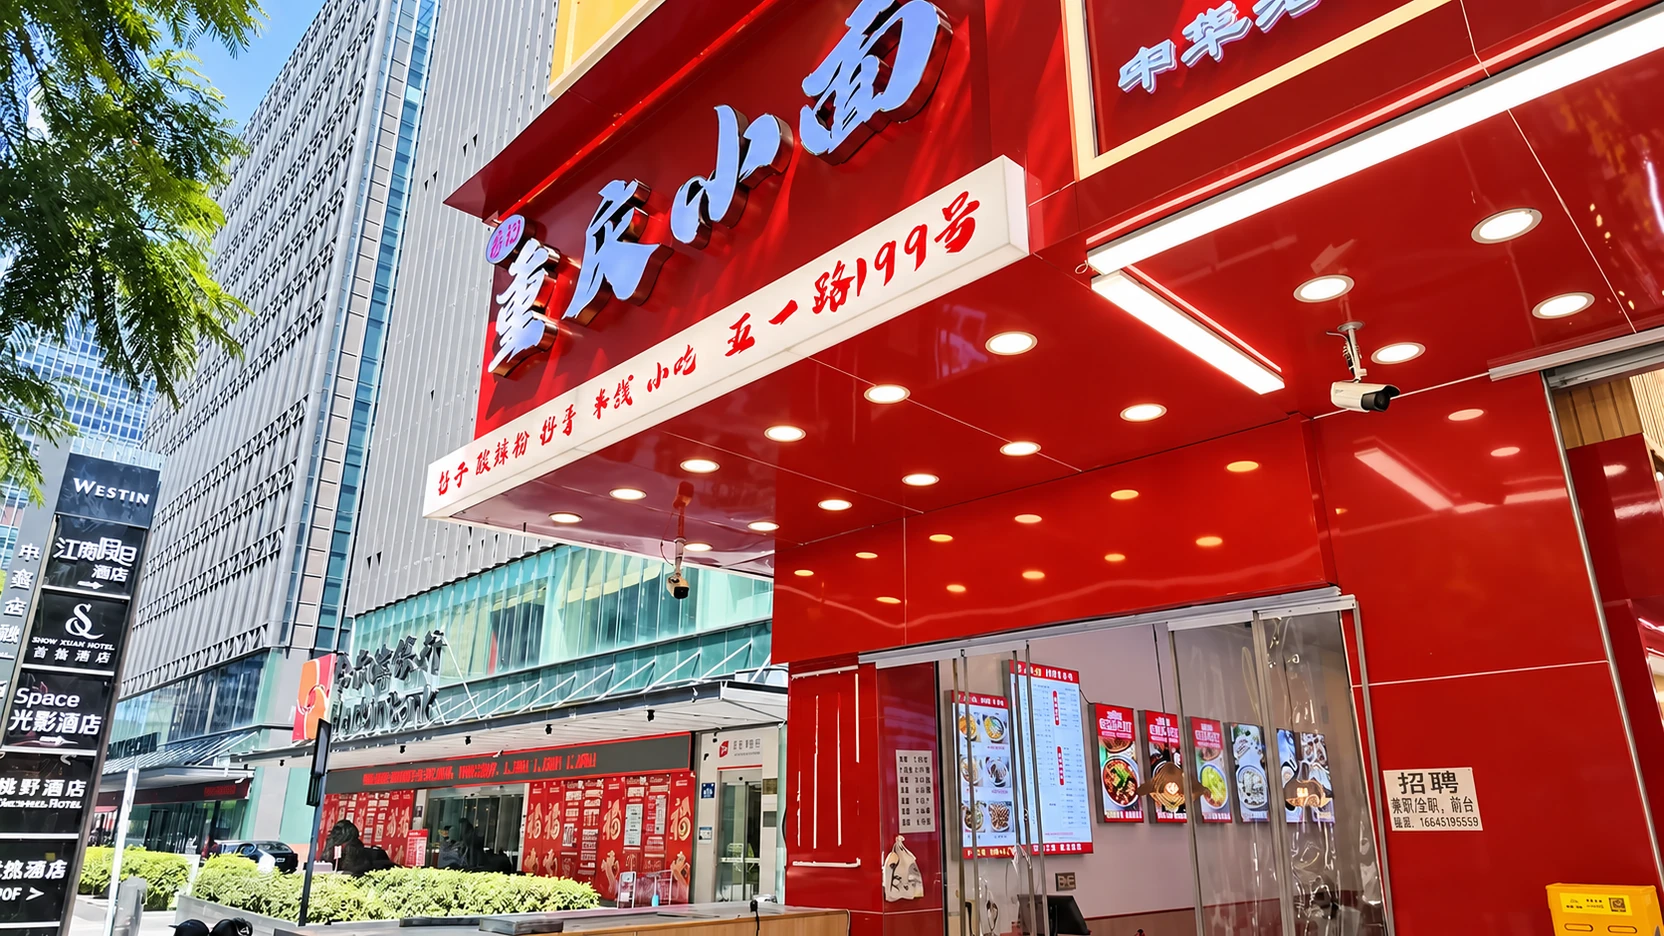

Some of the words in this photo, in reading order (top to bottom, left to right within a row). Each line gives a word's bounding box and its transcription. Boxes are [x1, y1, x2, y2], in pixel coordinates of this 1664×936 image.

[488, 0, 948, 373] 重庆小面
[647, 344, 697, 392] 小吃
[73, 477, 150, 505] WESTIN
[91, 564, 130, 582] 酒店
[87, 642, 115, 651] HOTEL
[14, 687, 81, 708] Space
[8, 708, 102, 736] 光影酒店
[1397, 770, 1459, 795] 招聘
